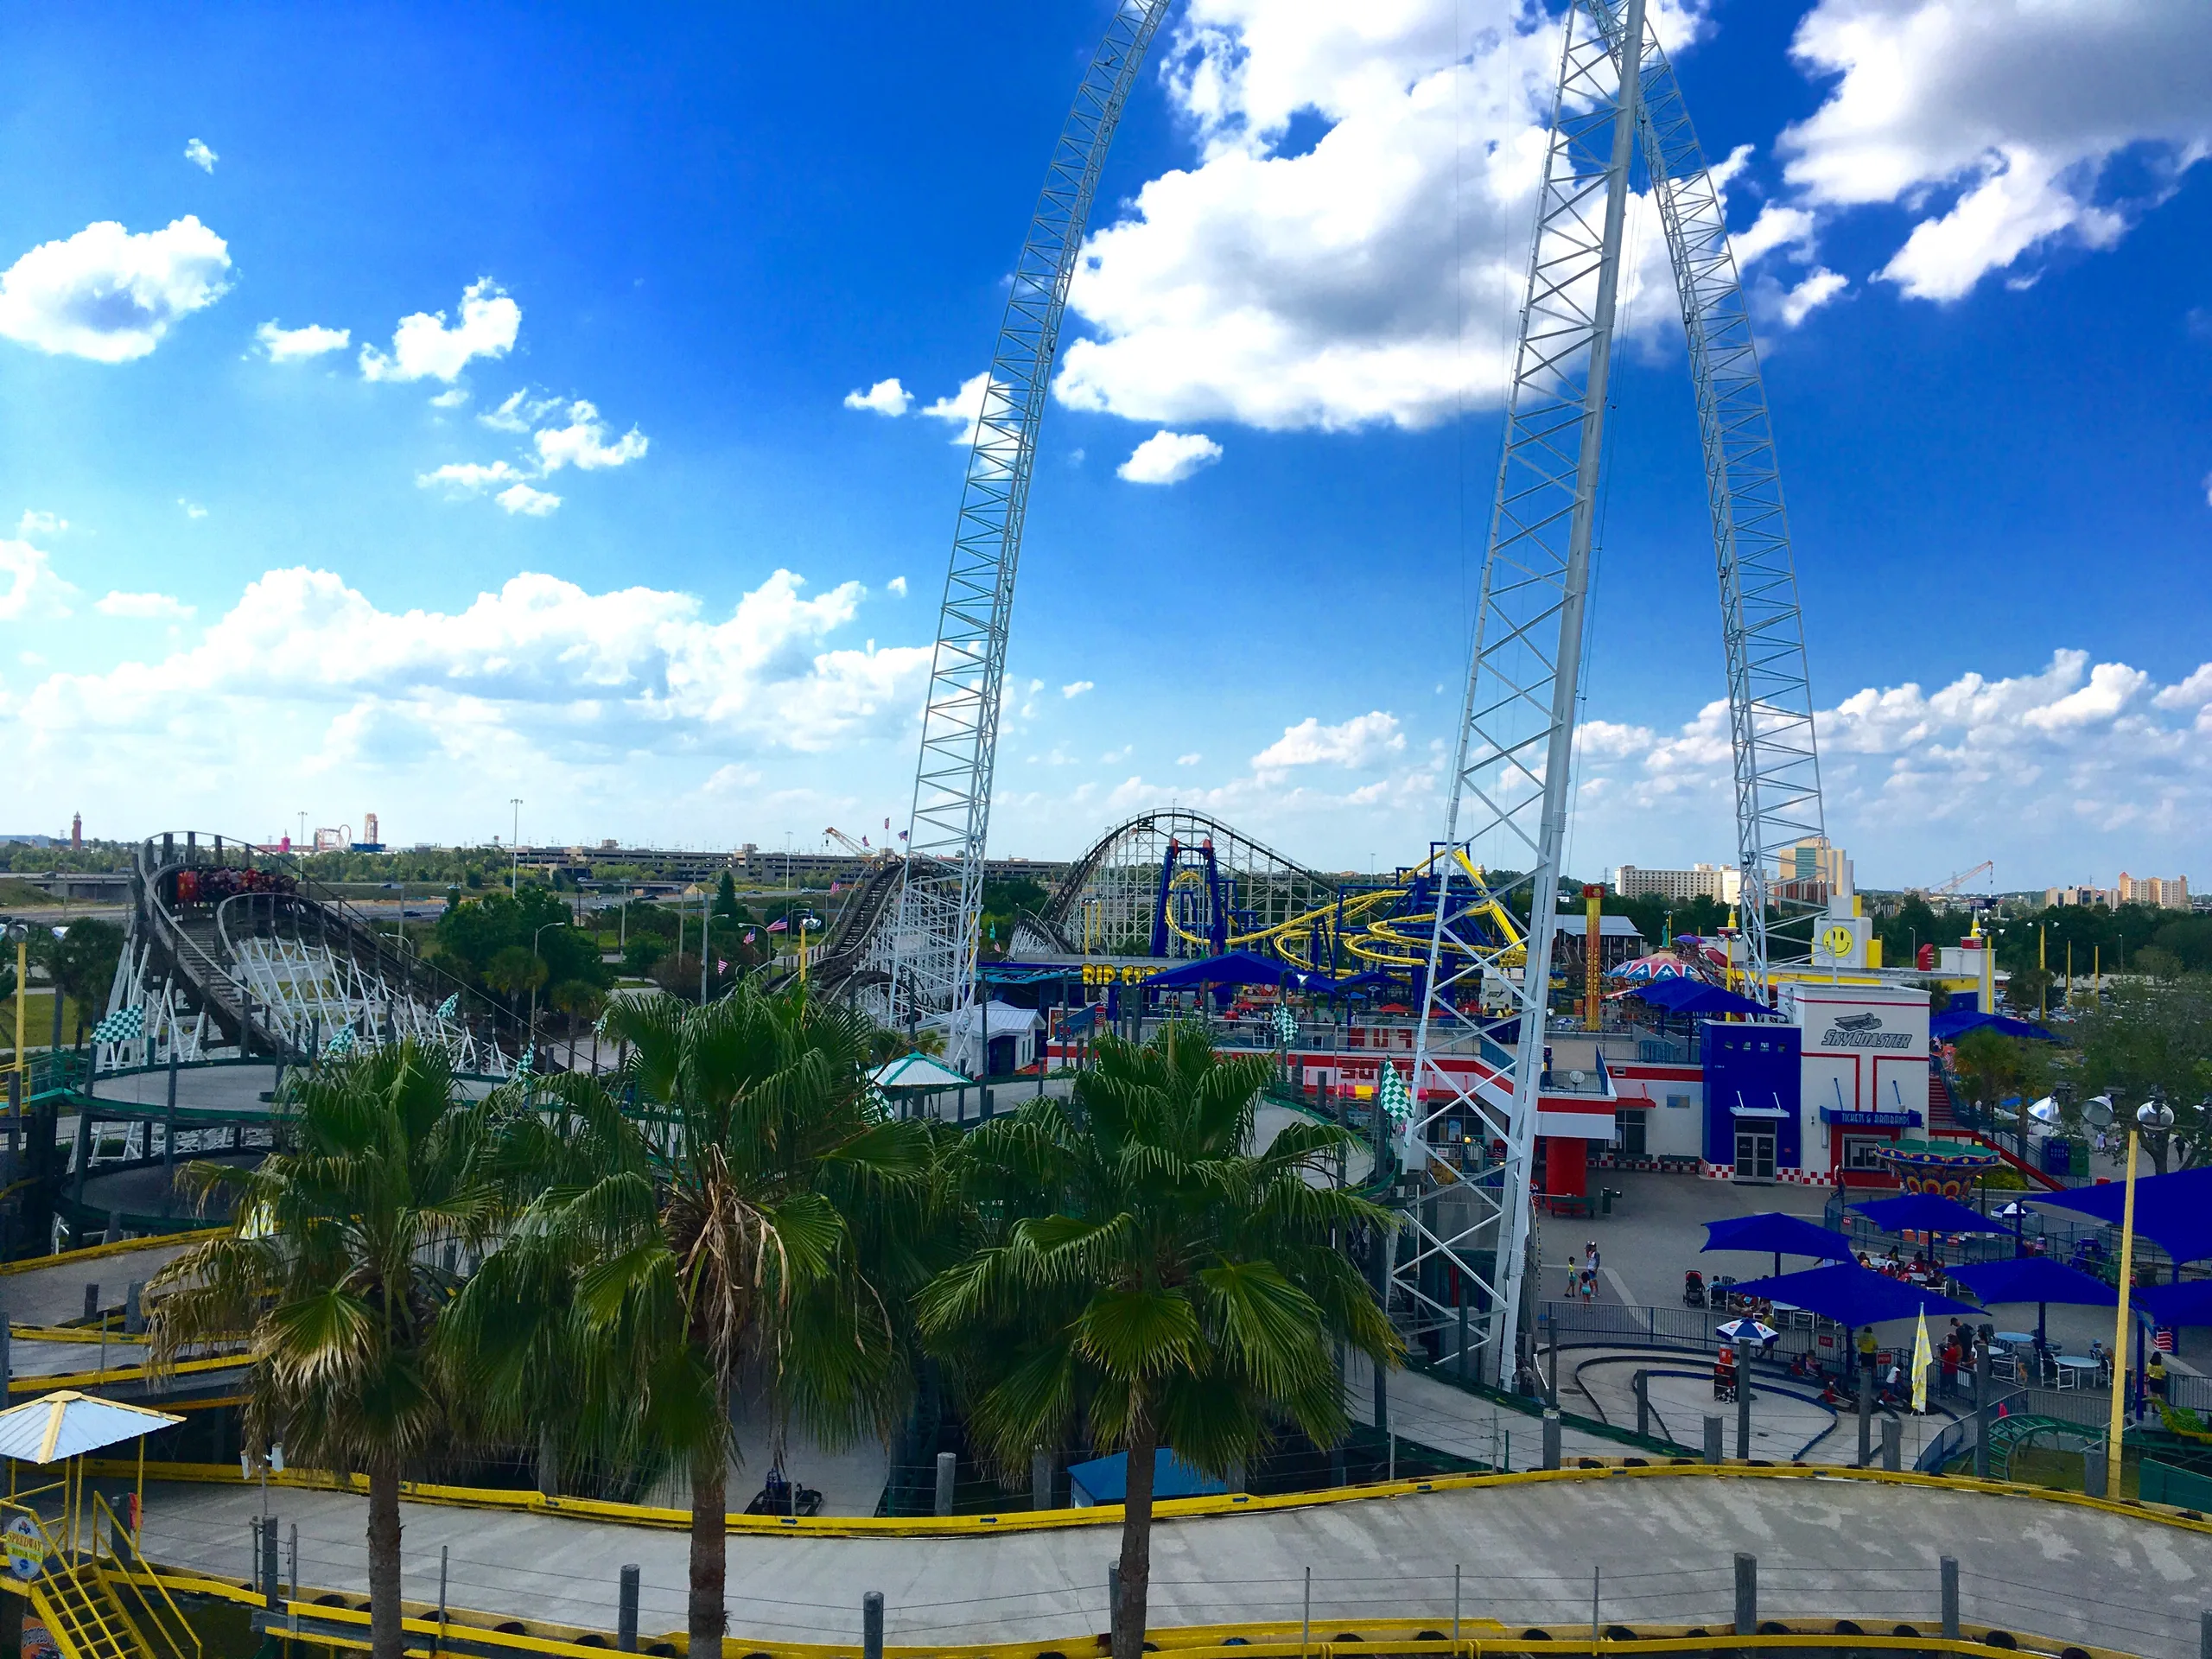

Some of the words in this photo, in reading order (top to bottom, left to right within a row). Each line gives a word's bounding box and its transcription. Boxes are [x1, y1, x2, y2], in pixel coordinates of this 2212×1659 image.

[1082, 963, 1116, 987] RIP
[1841, 1112, 1865, 1122] TICKETS
[1866, 1115, 1872, 1123] &
[1874, 1115, 1910, 1125] ARMBANDS
[8, 1533, 42, 1552] SPEEDWAY
